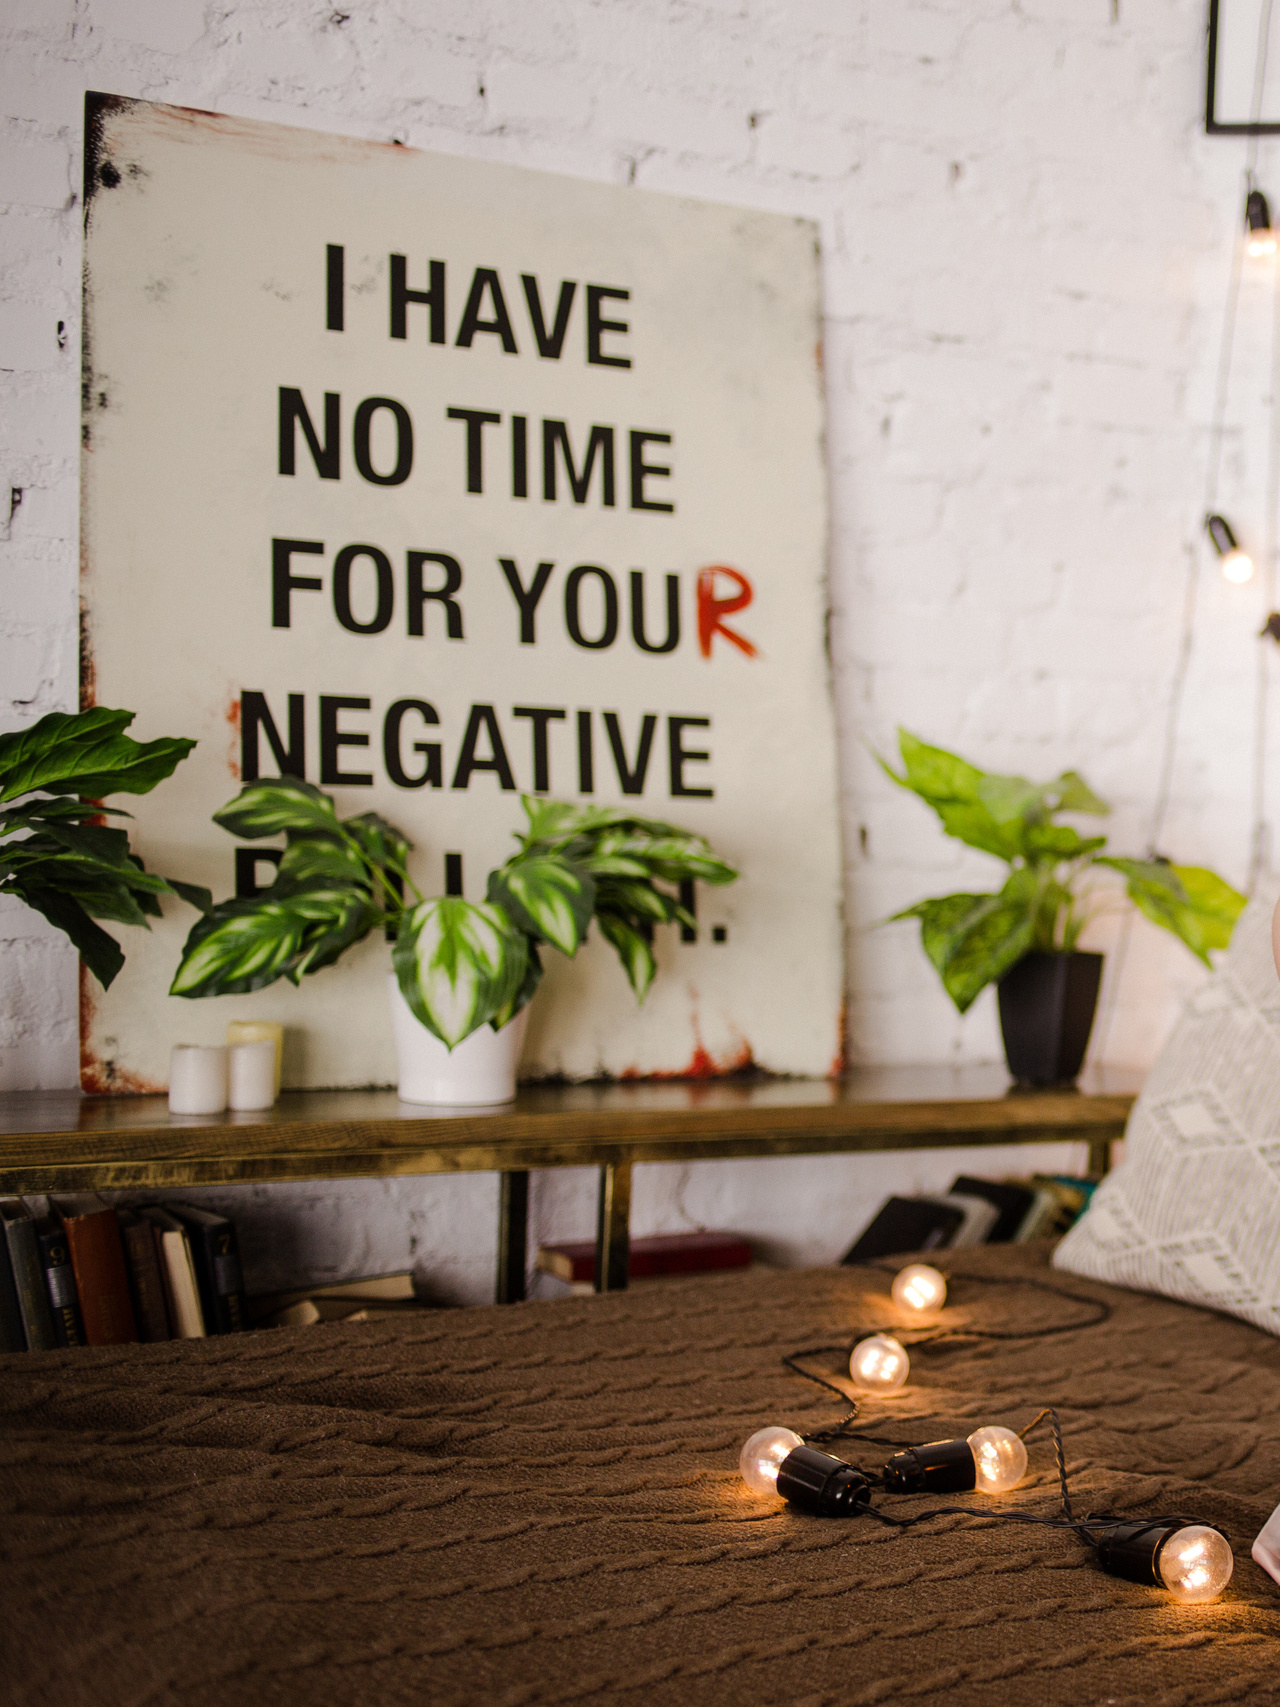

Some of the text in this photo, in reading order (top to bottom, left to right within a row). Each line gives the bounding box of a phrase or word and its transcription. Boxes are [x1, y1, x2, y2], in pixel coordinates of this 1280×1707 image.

[325, 243, 634, 370] I HAVE
[277, 385, 676, 515] NO TIME
[269, 537, 467, 643] FOR
[238, 690, 716, 799] NEGATIVE
[49, 1246, 66, 1266] 9
